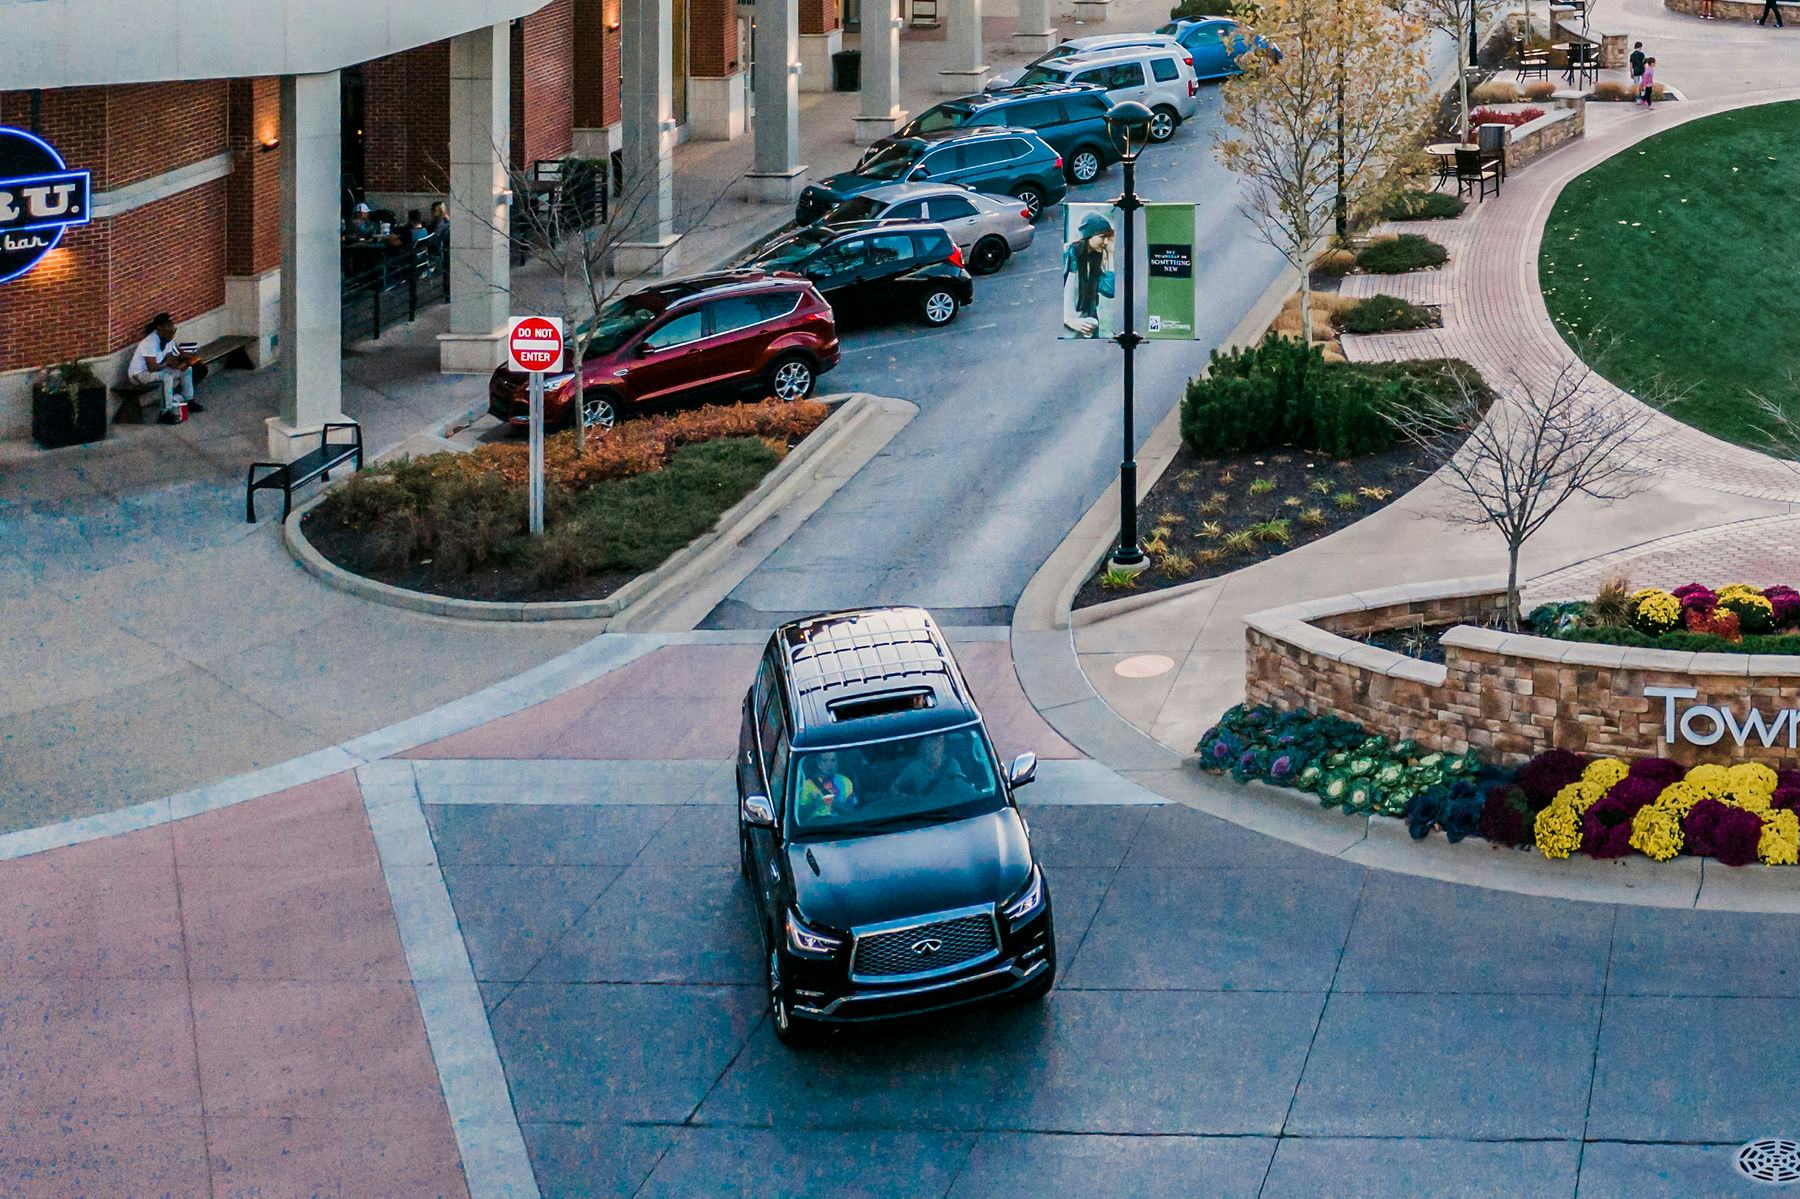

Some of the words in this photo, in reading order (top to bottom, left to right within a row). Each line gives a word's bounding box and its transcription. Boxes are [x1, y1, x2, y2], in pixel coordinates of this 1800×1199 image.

[5, 235, 49, 250] bar
[518, 328, 531, 337] DO
[535, 328, 553, 338] NOT
[521, 352, 550, 362] ENTER
